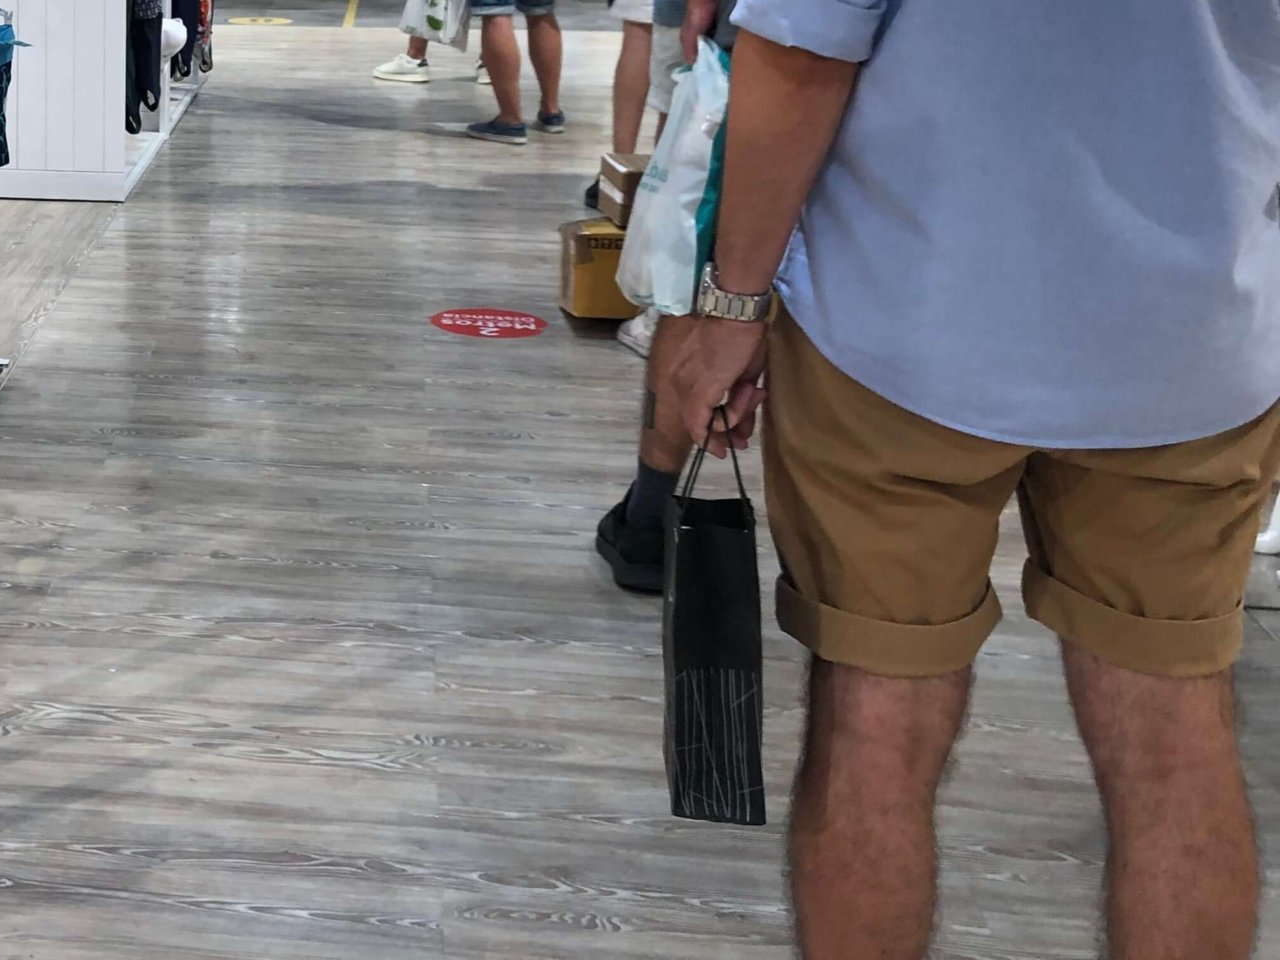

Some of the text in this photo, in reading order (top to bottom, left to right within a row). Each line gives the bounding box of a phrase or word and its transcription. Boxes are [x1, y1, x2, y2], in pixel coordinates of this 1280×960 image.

[441, 313, 535, 323] Distancia
[440, 319, 536, 330] Metros
[479, 326, 500, 336] 2
